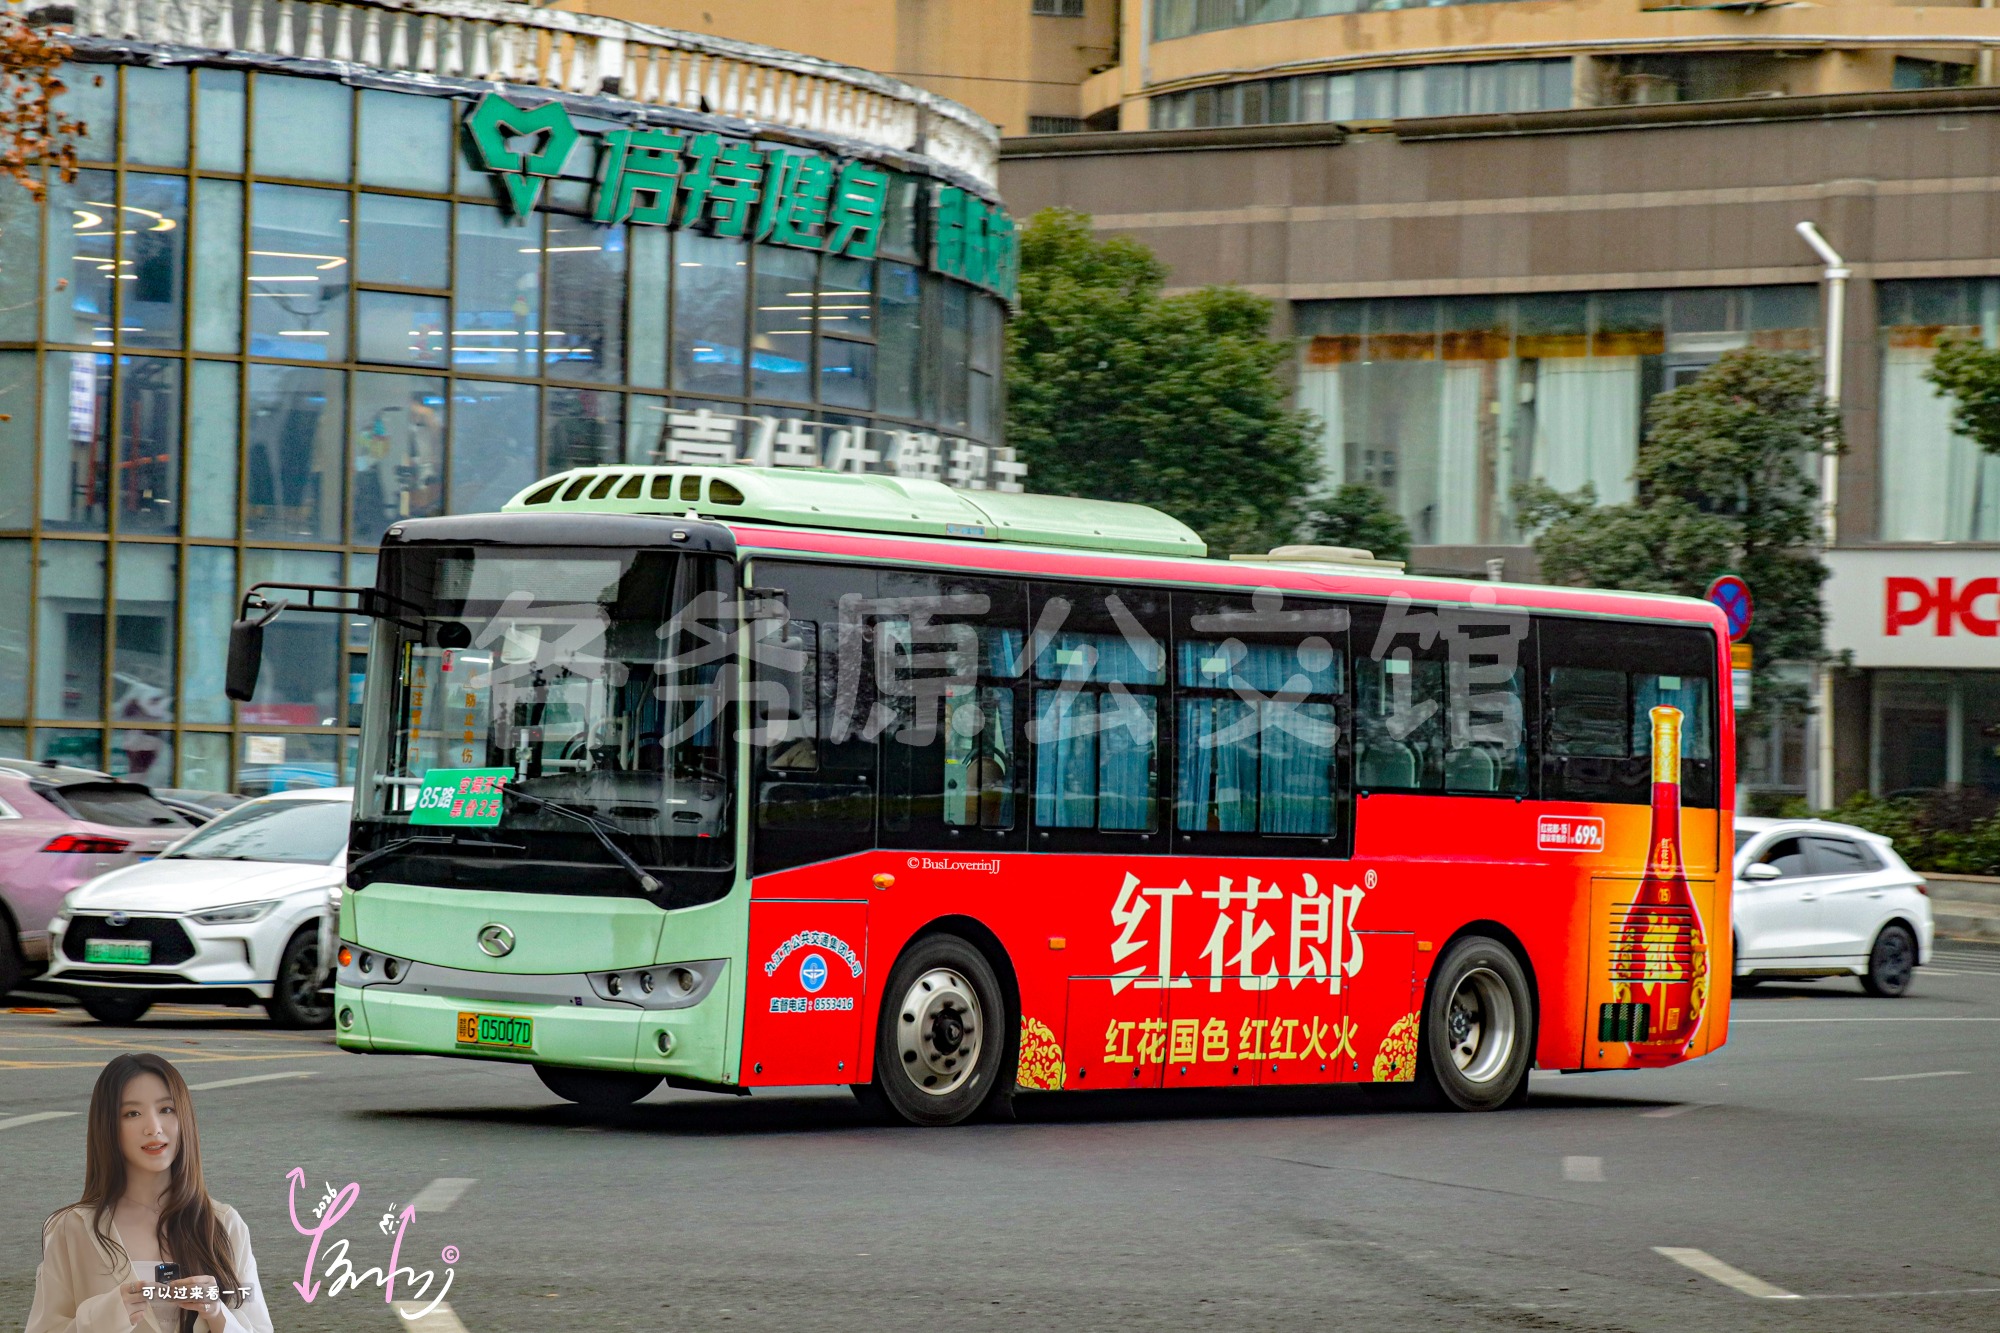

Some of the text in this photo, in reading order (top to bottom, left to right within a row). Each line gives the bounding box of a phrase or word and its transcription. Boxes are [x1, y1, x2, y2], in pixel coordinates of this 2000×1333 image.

[1884, 577, 2000, 637] PIC
[419, 787, 455, 809] 85路
[450, 799, 500, 818] 票价2元
[765, 930, 863, 978] 九江市公共交通集团公司
[1103, 1016, 1358, 1065] 红花国色 红红火火
